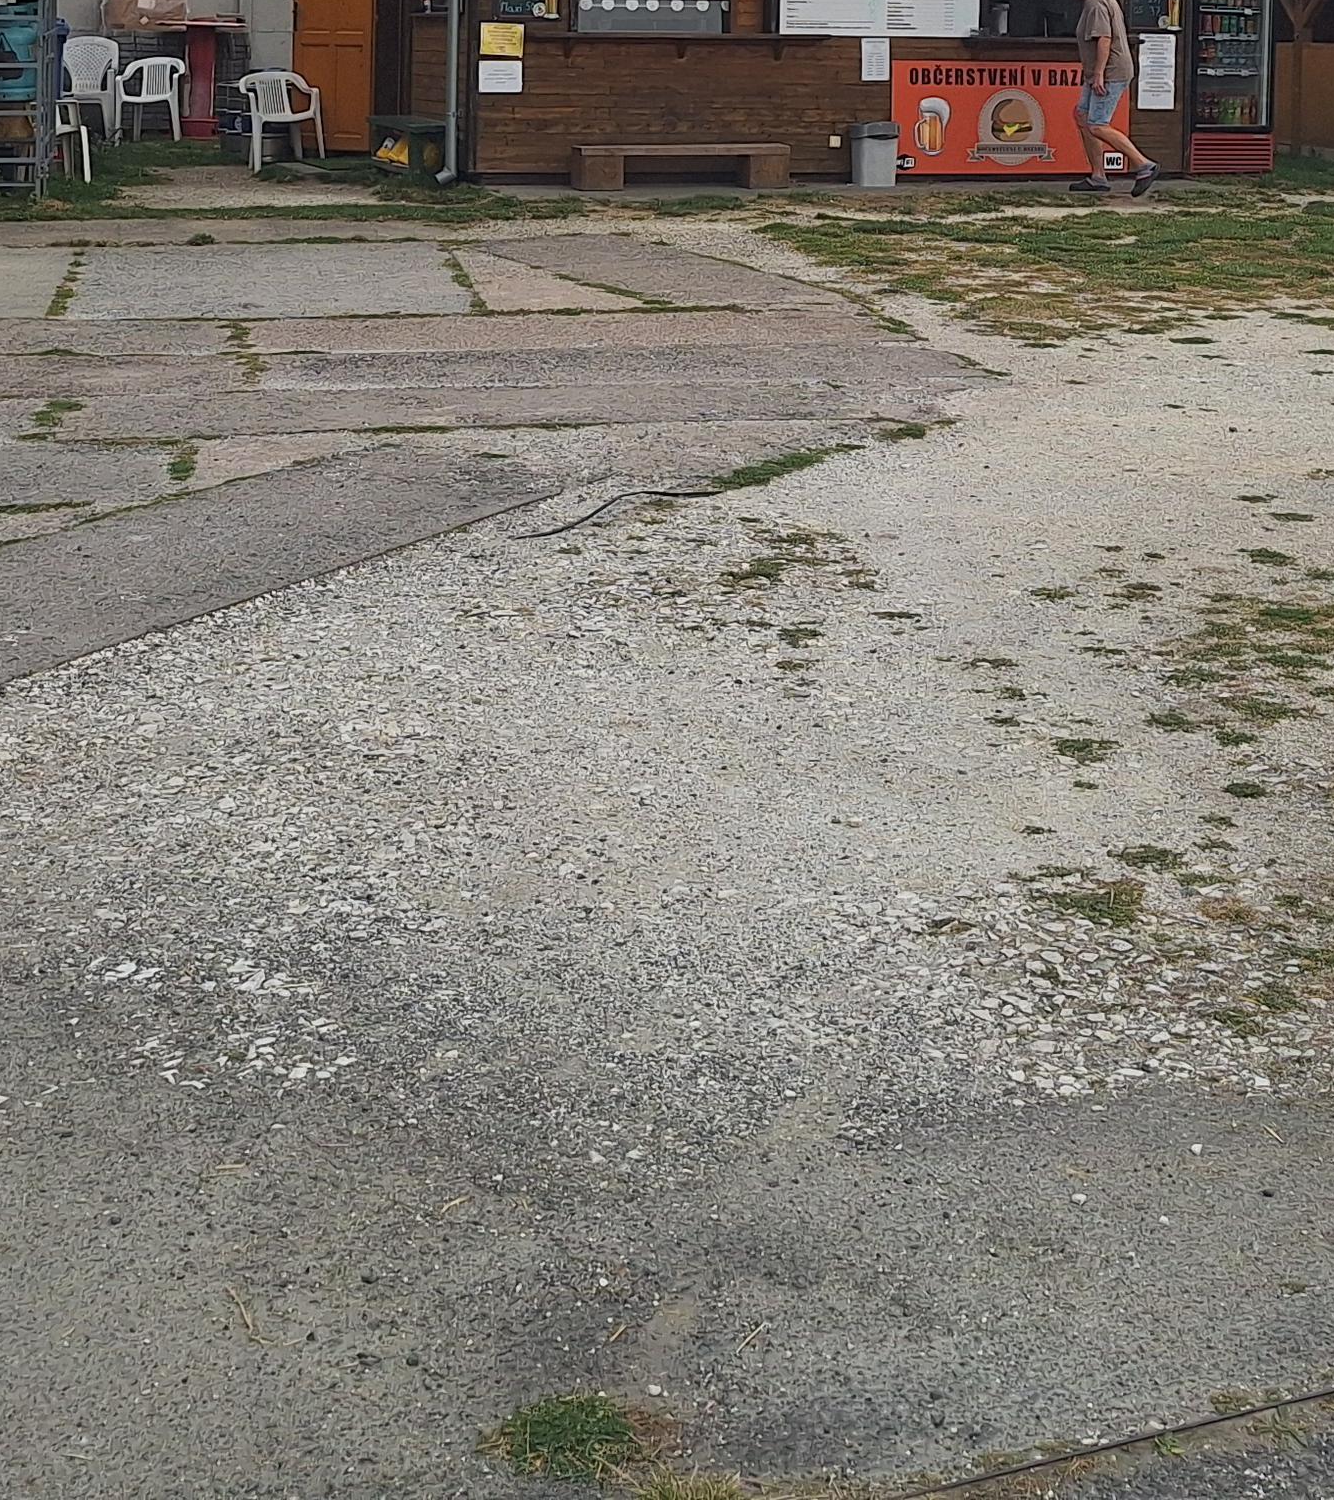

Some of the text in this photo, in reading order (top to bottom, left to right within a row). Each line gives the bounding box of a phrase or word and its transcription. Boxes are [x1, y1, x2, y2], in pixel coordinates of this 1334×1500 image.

[909, 65, 1025, 87] OBČERSTVENÍ
[1031, 69, 1042, 87] V
[1106, 156, 1122, 167] WC
